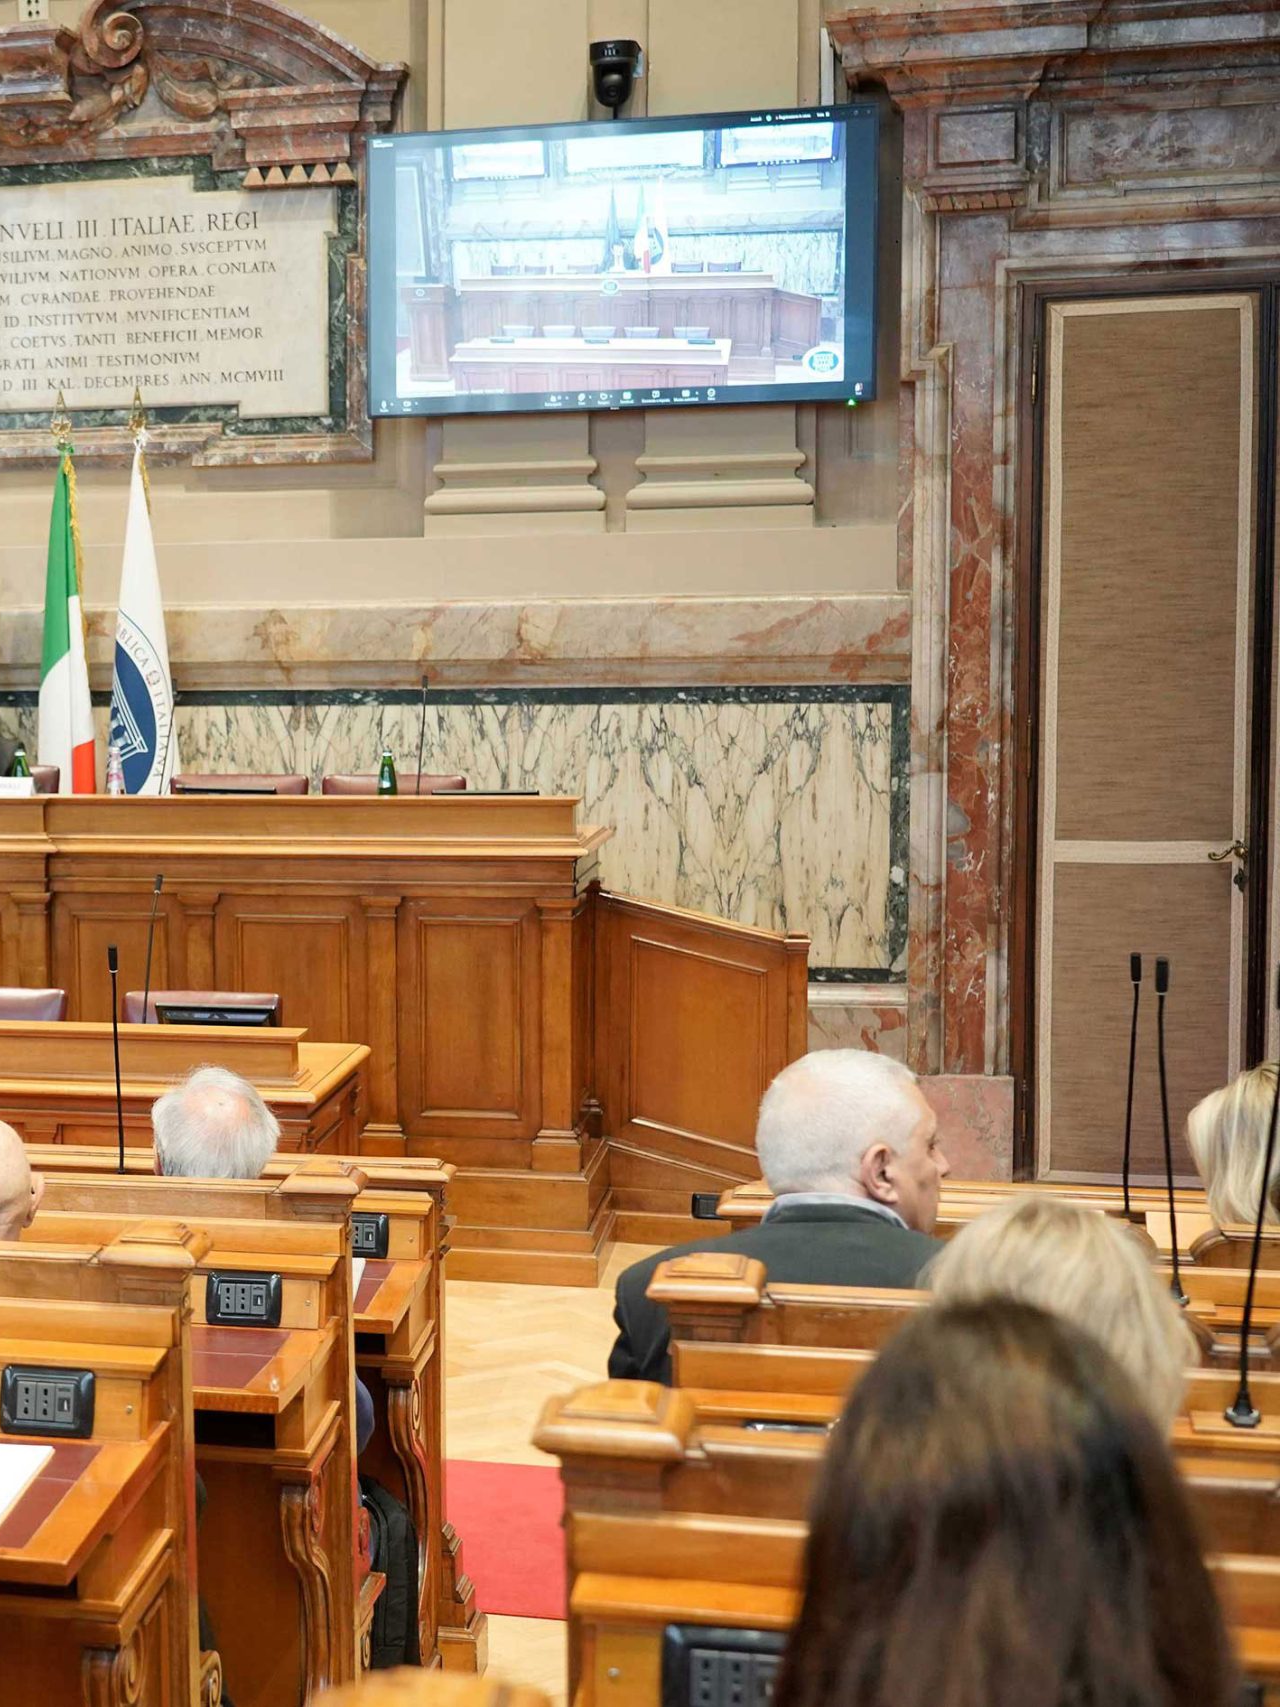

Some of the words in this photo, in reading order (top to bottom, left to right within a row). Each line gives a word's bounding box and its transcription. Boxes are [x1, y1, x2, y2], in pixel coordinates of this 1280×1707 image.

[77, 220, 97, 238] III
[112, 215, 194, 236] ITALIAE
[207, 211, 259, 232] REGI
[58, 247, 113, 260] MAGNO
[121, 244, 172, 257] ANIMO
[181, 239, 267, 255] SVSCEPTVM
[60, 268, 140, 282] NATIONVM
[149, 265, 198, 278] OPERA
[207, 261, 276, 275] CONLATA
[21, 290, 101, 306] CVRANDAE
[109, 286, 216, 301] PROVEHENDAE
[4, 316, 19, 327] ID
[29, 312, 117, 327] INSTITVTVM
[127, 307, 250, 321] MVNIFICENTIAM
[11, 336, 66, 349] COETVS
[76, 334, 116, 345] TANTI
[127, 330, 197, 343] BENEFICII
[207, 327, 263, 340] MEMOR
[47, 357, 88, 368] ANIMI
[98, 352, 200, 367] TESTIMONIVM
[23, 379, 37, 390] III
[48, 378, 75, 390] KAL
[181, 372, 211, 385] ANN
[221, 369, 284, 384] MCMVIII
